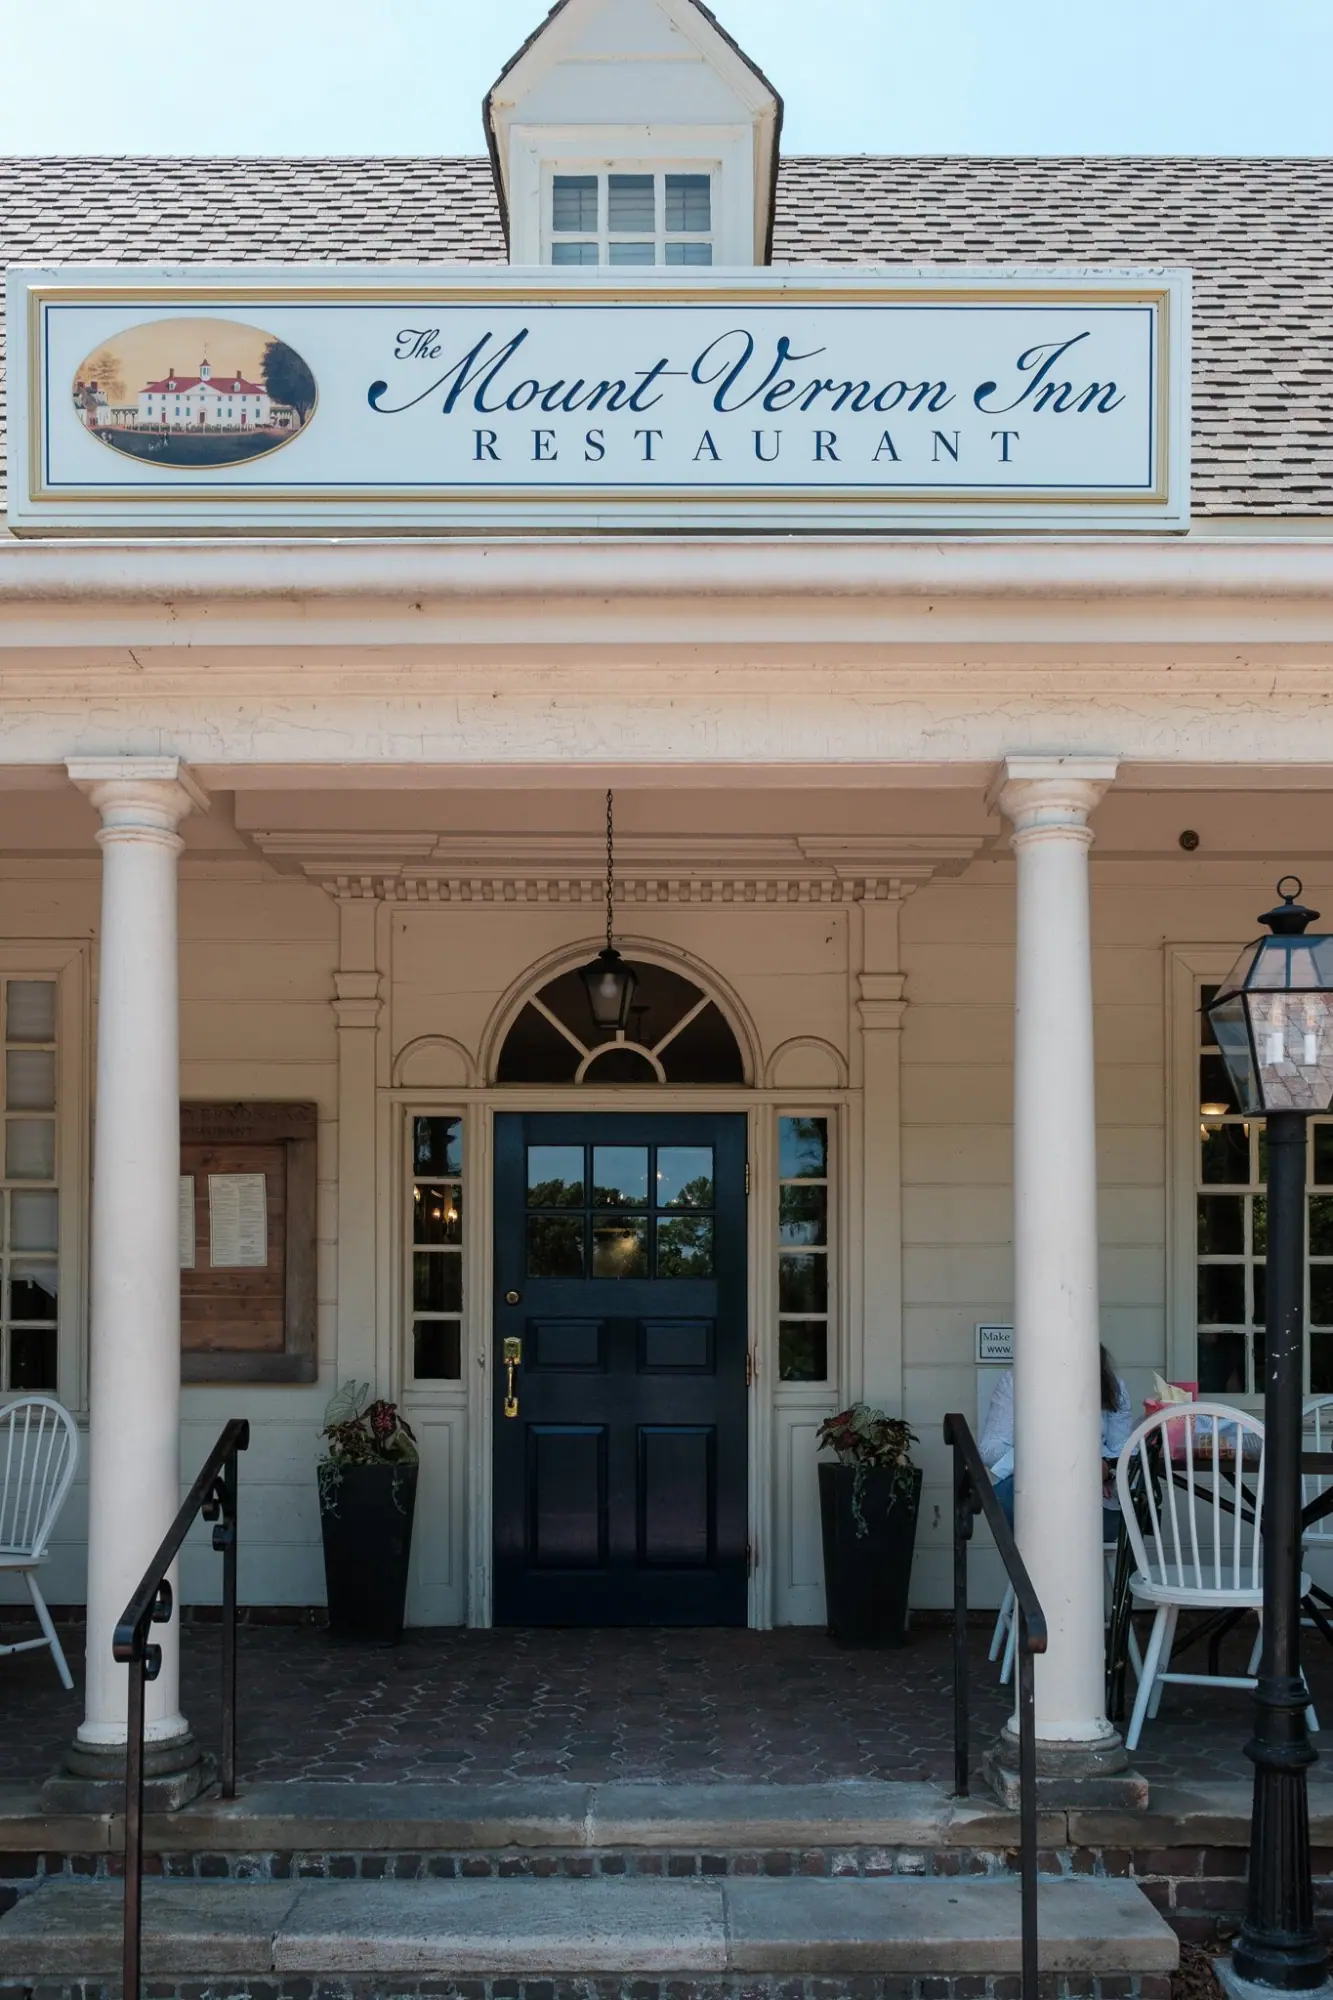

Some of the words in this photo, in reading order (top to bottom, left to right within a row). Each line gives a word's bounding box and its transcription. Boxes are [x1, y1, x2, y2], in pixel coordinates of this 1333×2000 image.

[367, 328, 689, 414] Mount
[393, 328, 442, 360] The
[691, 329, 957, 412] Vernon
[973, 331, 1126, 414] Inn
[472, 429, 1020, 462] RESTAURANT
[983, 1332, 1010, 1341] Make
